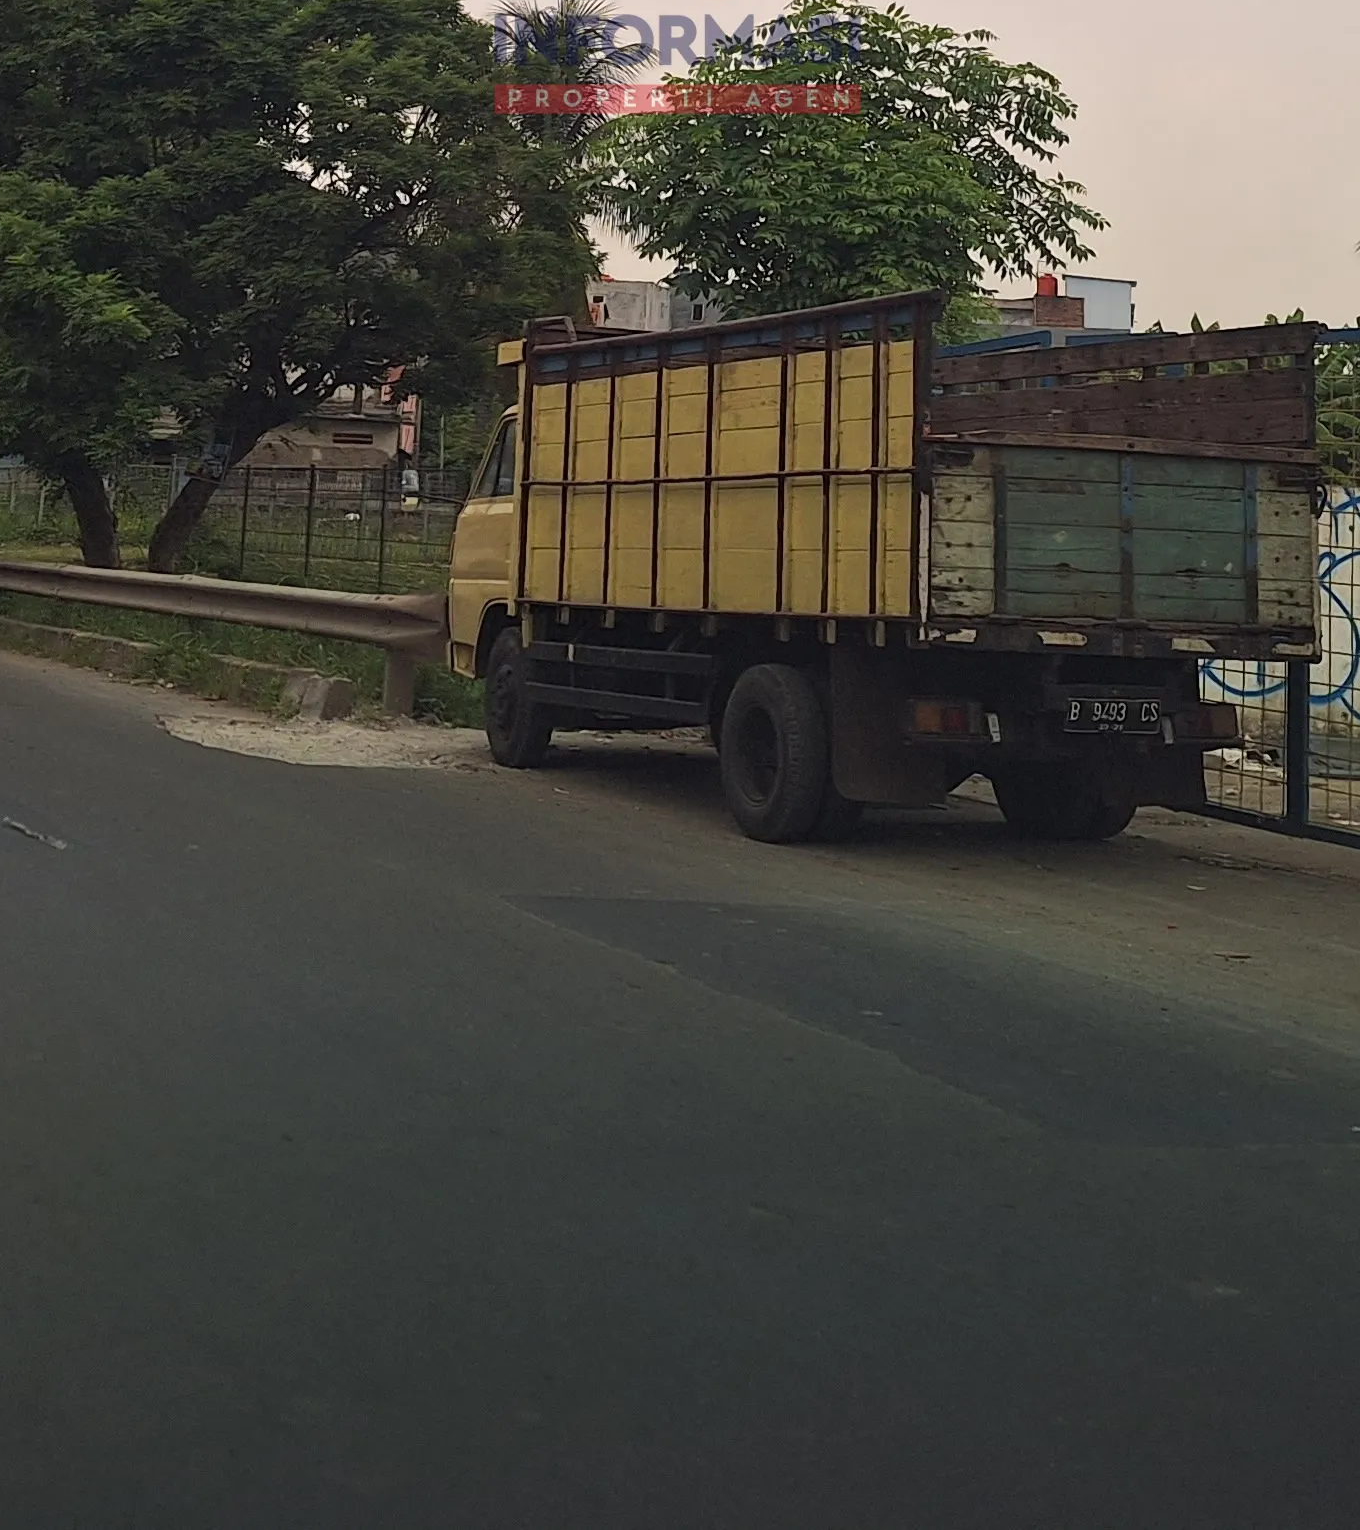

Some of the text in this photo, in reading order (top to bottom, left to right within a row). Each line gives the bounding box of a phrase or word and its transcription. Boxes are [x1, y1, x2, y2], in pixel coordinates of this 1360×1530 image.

[1069, 701, 1159, 722] B 9493 CS
